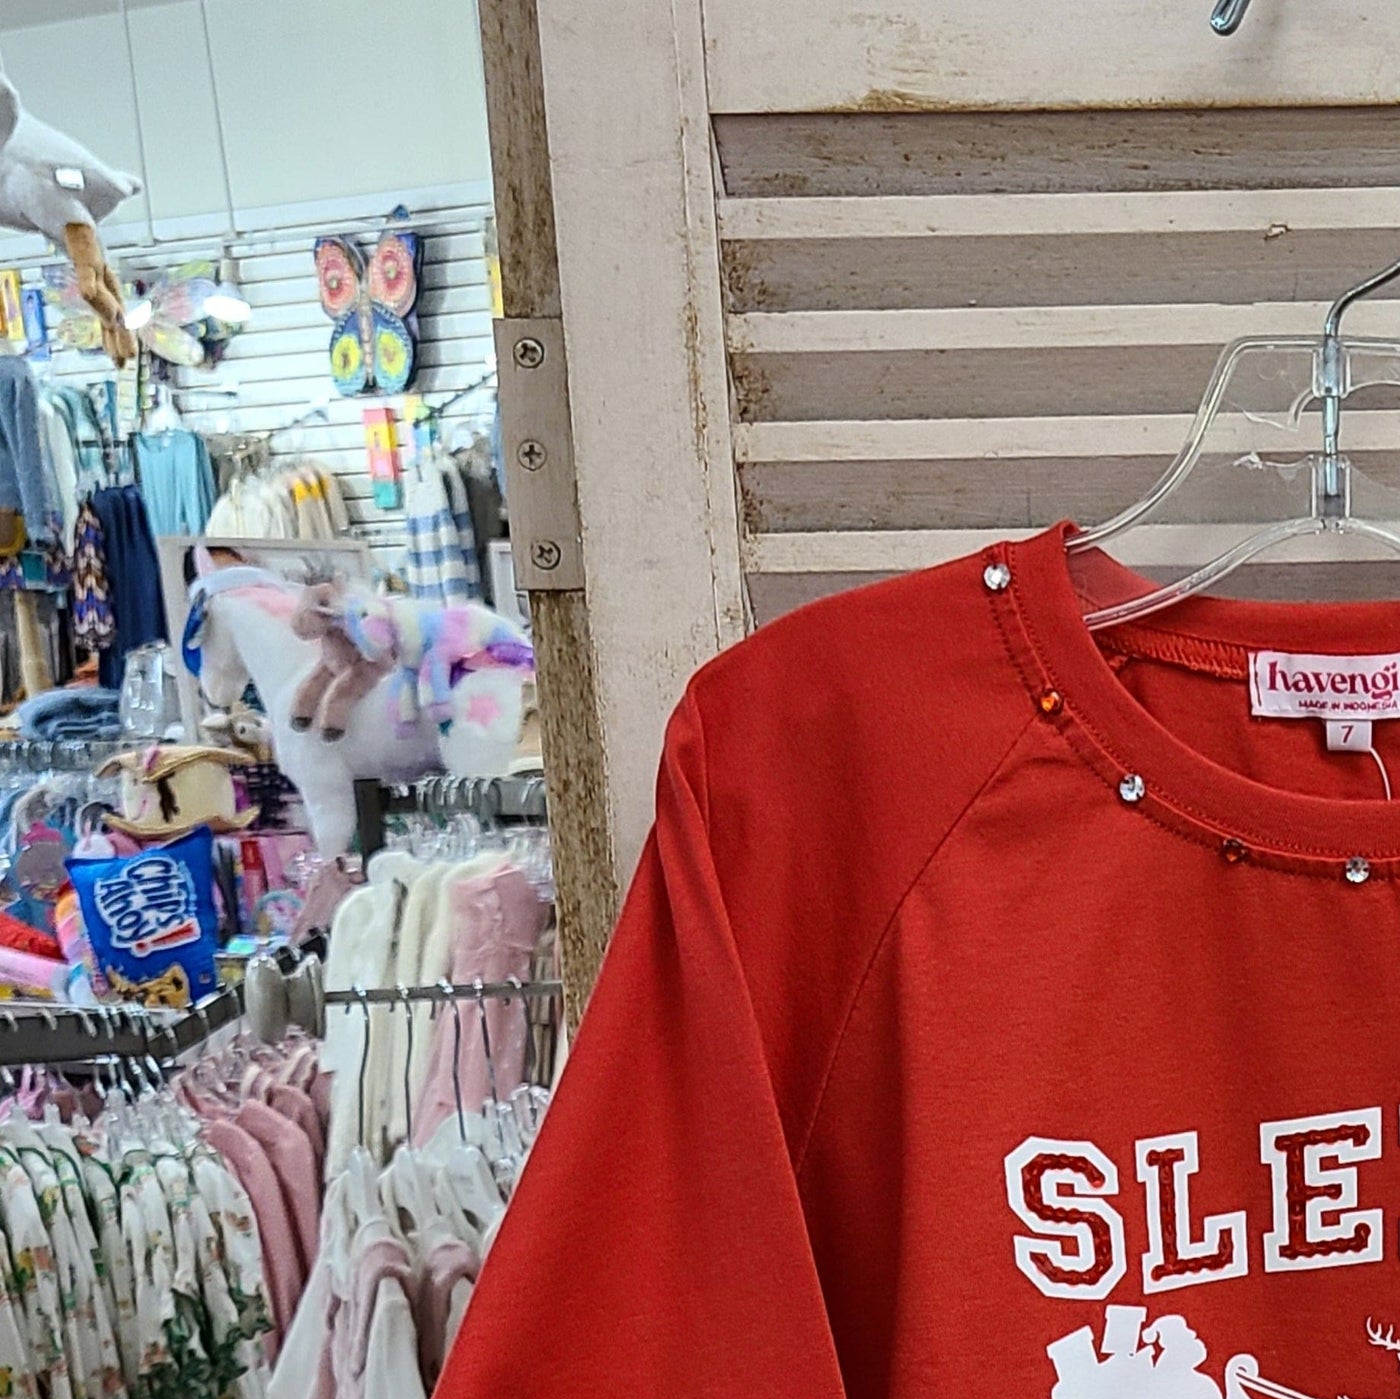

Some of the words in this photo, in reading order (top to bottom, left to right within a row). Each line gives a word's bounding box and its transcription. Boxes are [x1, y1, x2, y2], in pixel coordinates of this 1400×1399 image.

[1298, 700, 1328, 711] MADE
[1331, 702, 1341, 711] IN
[1343, 701, 1398, 711] INDONESIA
[1340, 724, 1355, 744] 7
[126, 857, 185, 928] Chips
